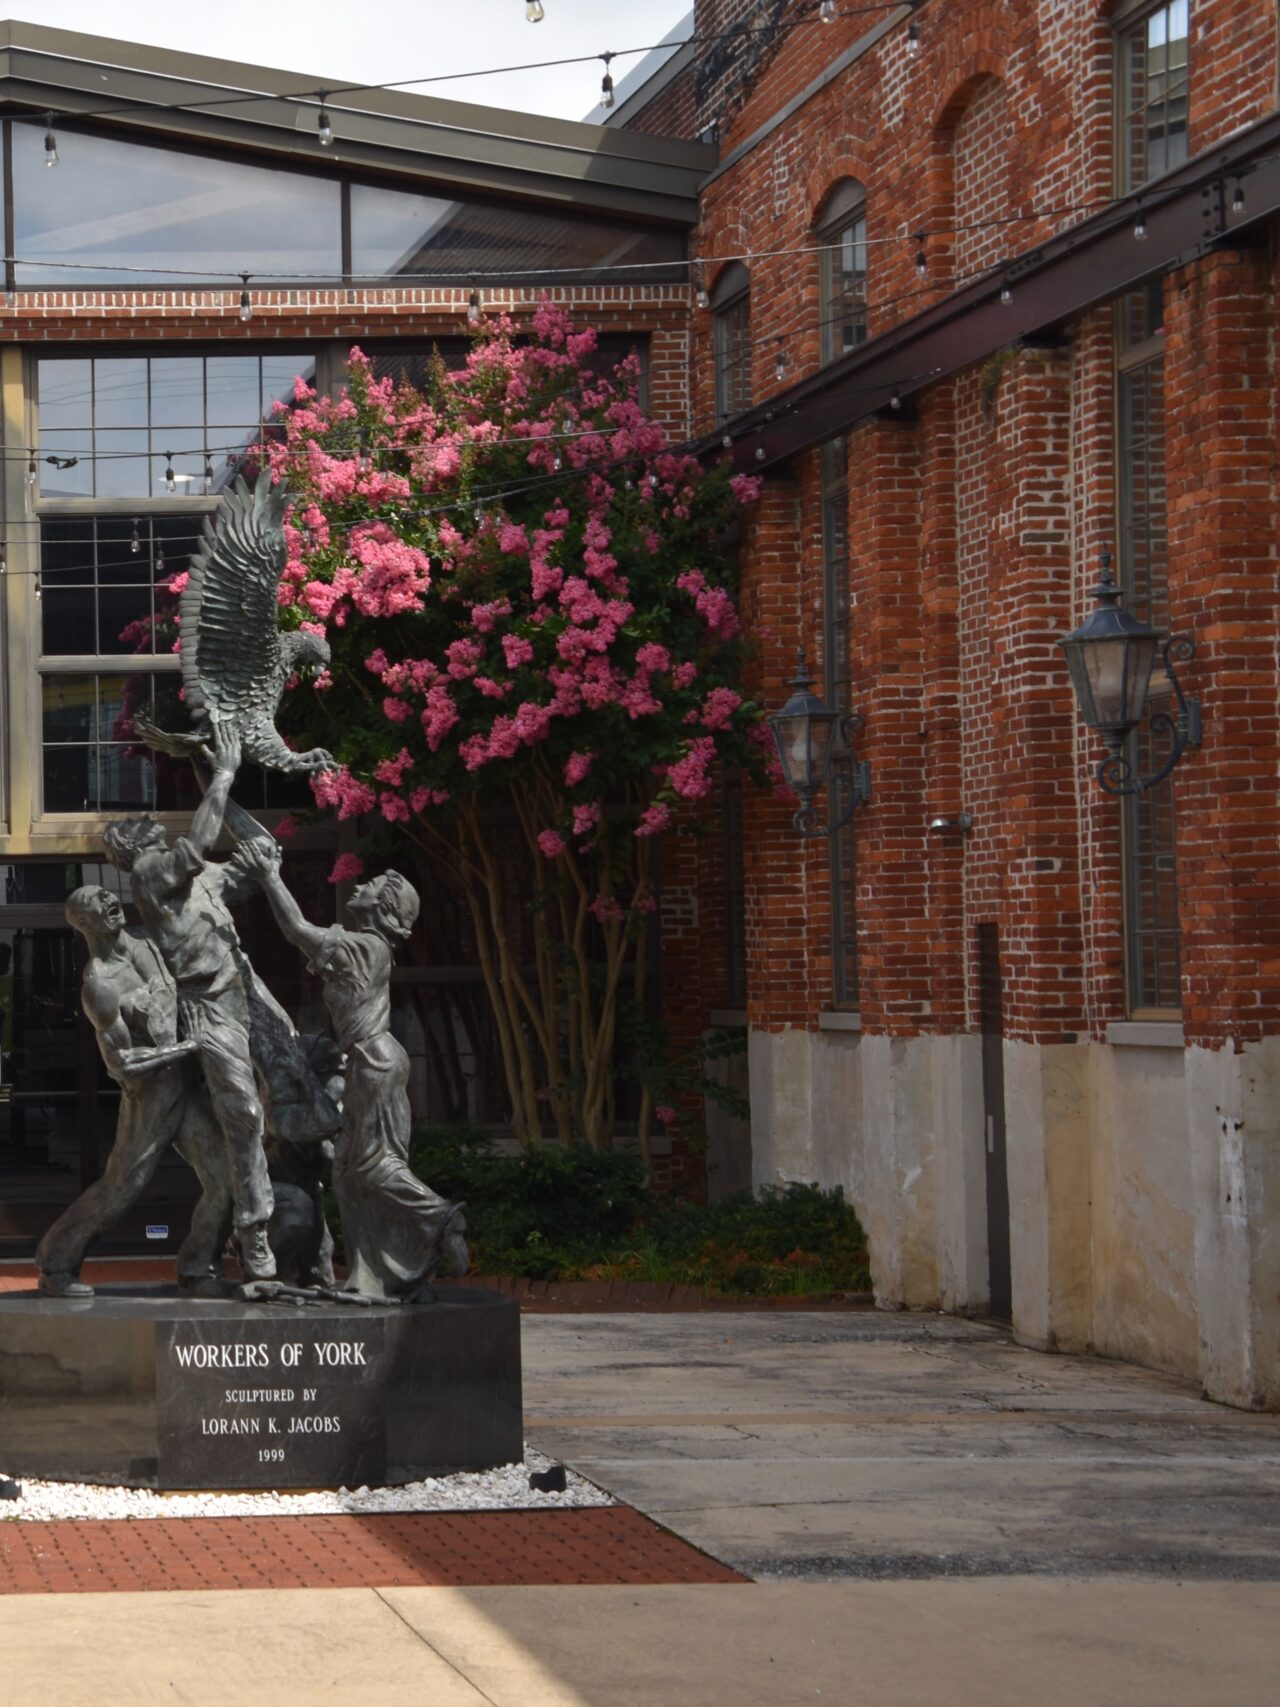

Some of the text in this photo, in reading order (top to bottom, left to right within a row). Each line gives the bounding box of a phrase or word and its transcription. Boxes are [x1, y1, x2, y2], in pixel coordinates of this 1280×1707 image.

[175, 1342, 367, 1368] WORKERS OF YORK
[225, 1388, 317, 1403] SCULPTURED BY
[201, 1416, 341, 1435] LORANN K. JACOBS
[258, 1449, 285, 1462] 1999
